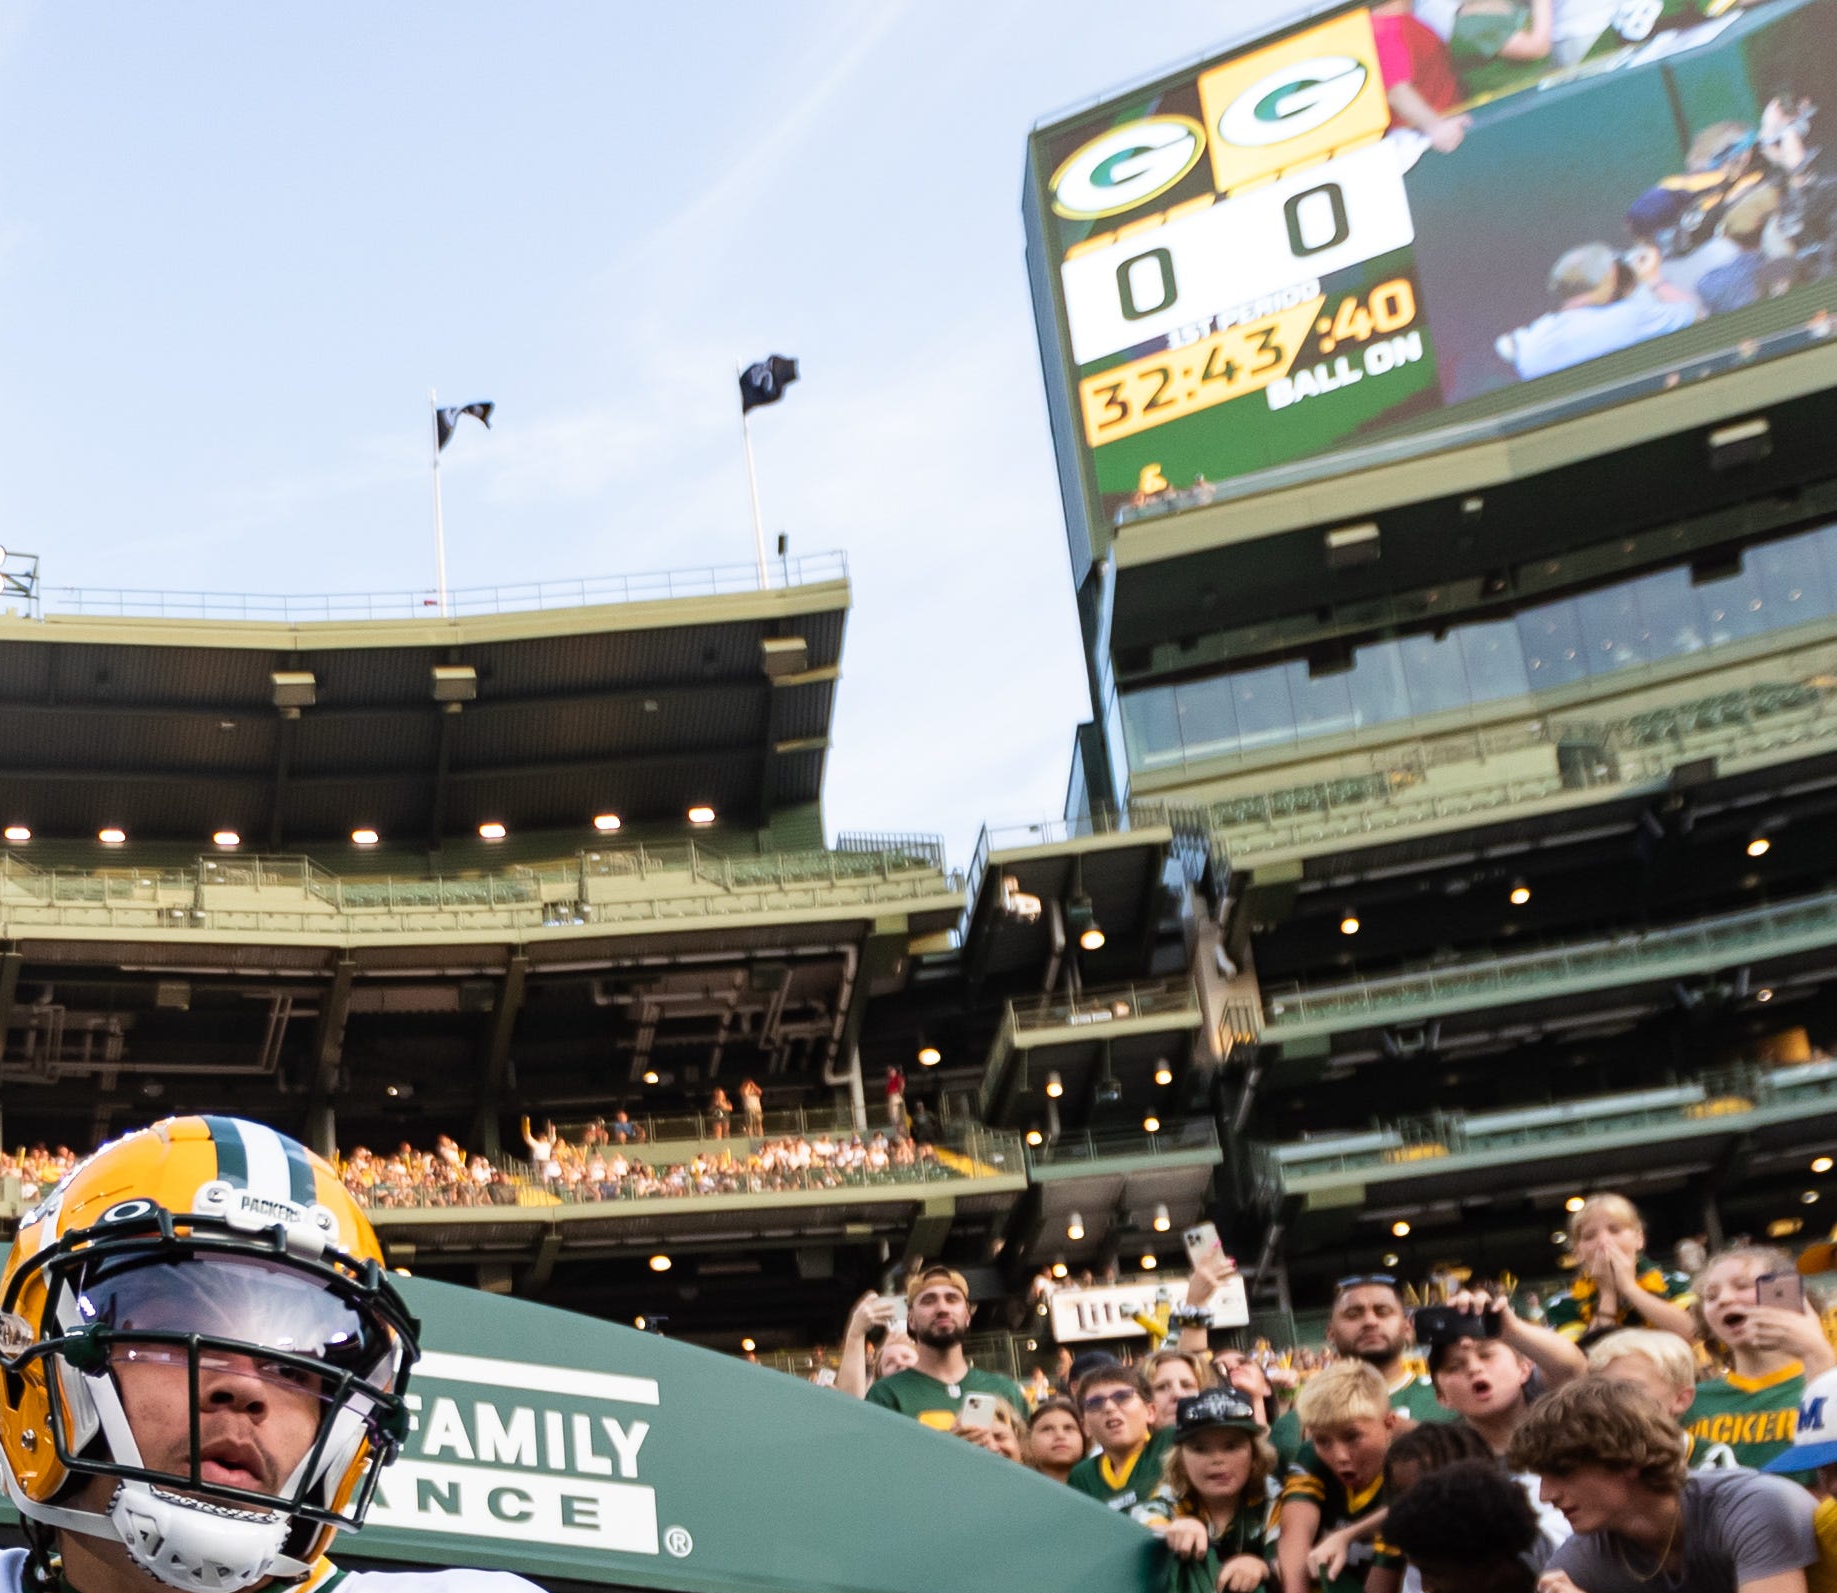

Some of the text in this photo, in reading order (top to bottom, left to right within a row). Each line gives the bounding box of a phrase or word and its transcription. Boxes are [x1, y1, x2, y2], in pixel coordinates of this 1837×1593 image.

[1116, 182, 1348, 321] 0 0
[1093, 277, 1416, 433] 32:43 :40
[1266, 331, 1423, 411] BALL ON
[241, 1195, 303, 1224] PACKERS
